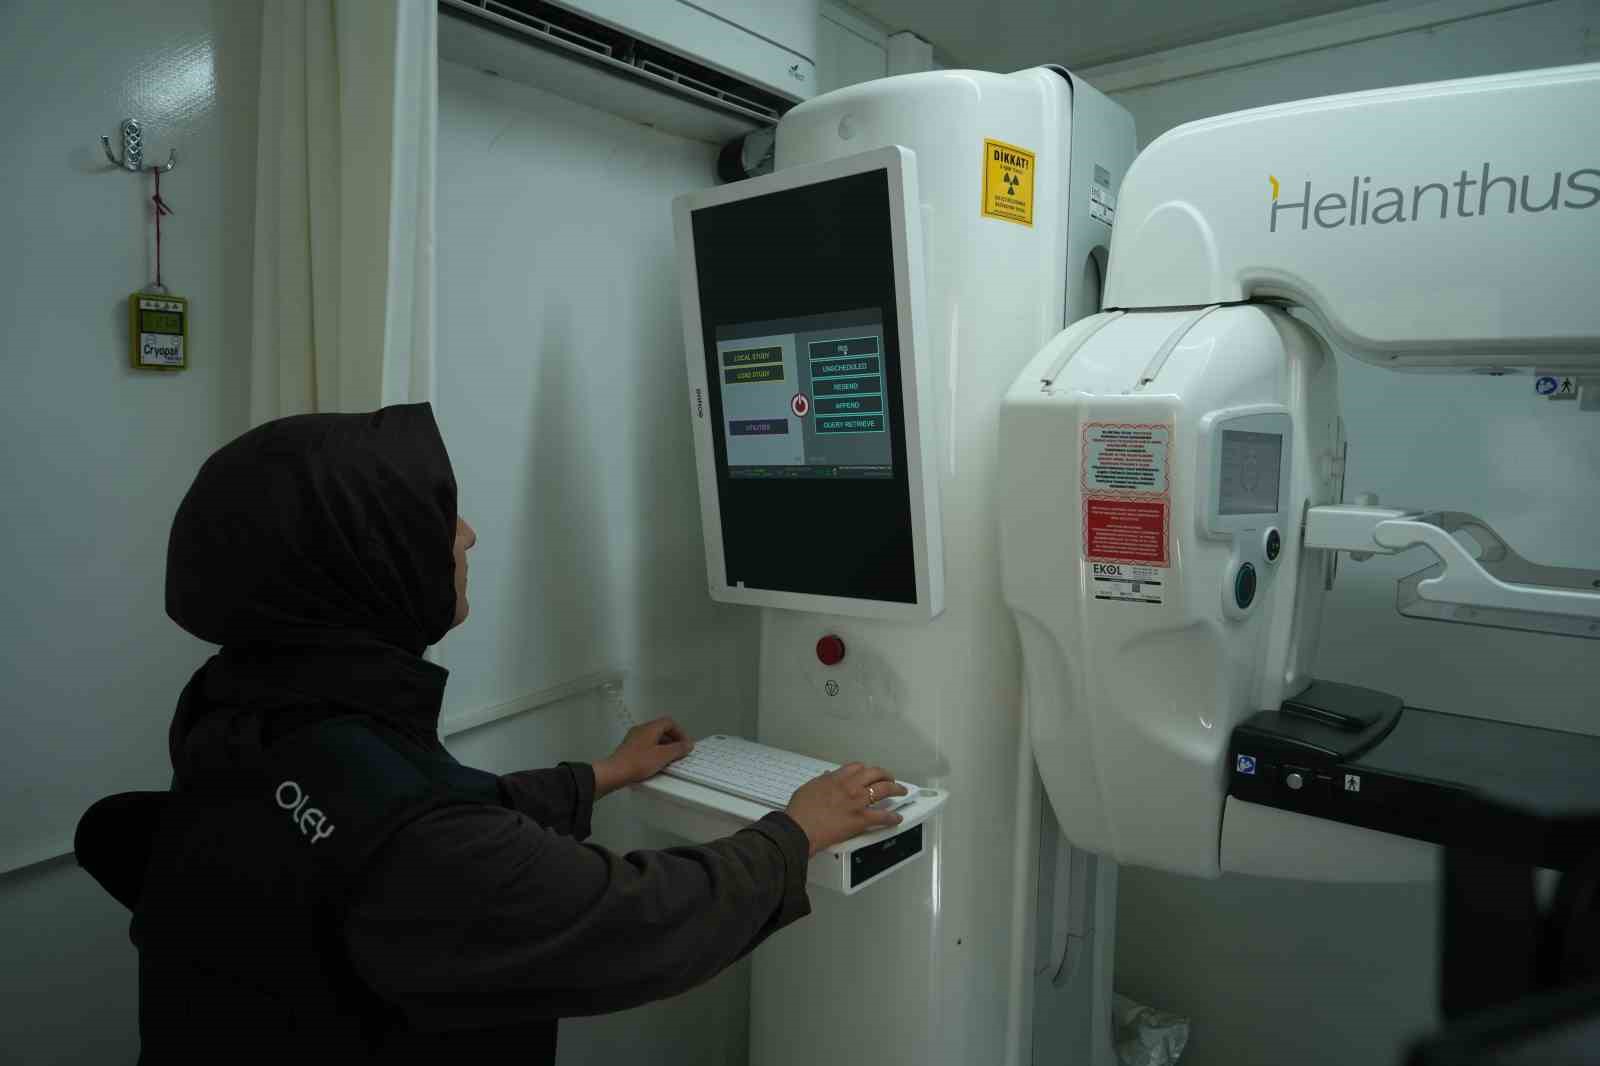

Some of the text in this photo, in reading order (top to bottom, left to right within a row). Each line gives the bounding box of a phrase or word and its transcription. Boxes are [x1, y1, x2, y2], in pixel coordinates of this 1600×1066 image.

[1269, 162, 1600, 233] Helianthus
[822, 362, 868, 373] UNSCHEDULED
[823, 419, 876, 429] QUERY RETRIEVE
[1093, 564, 1122, 576] EKOL
